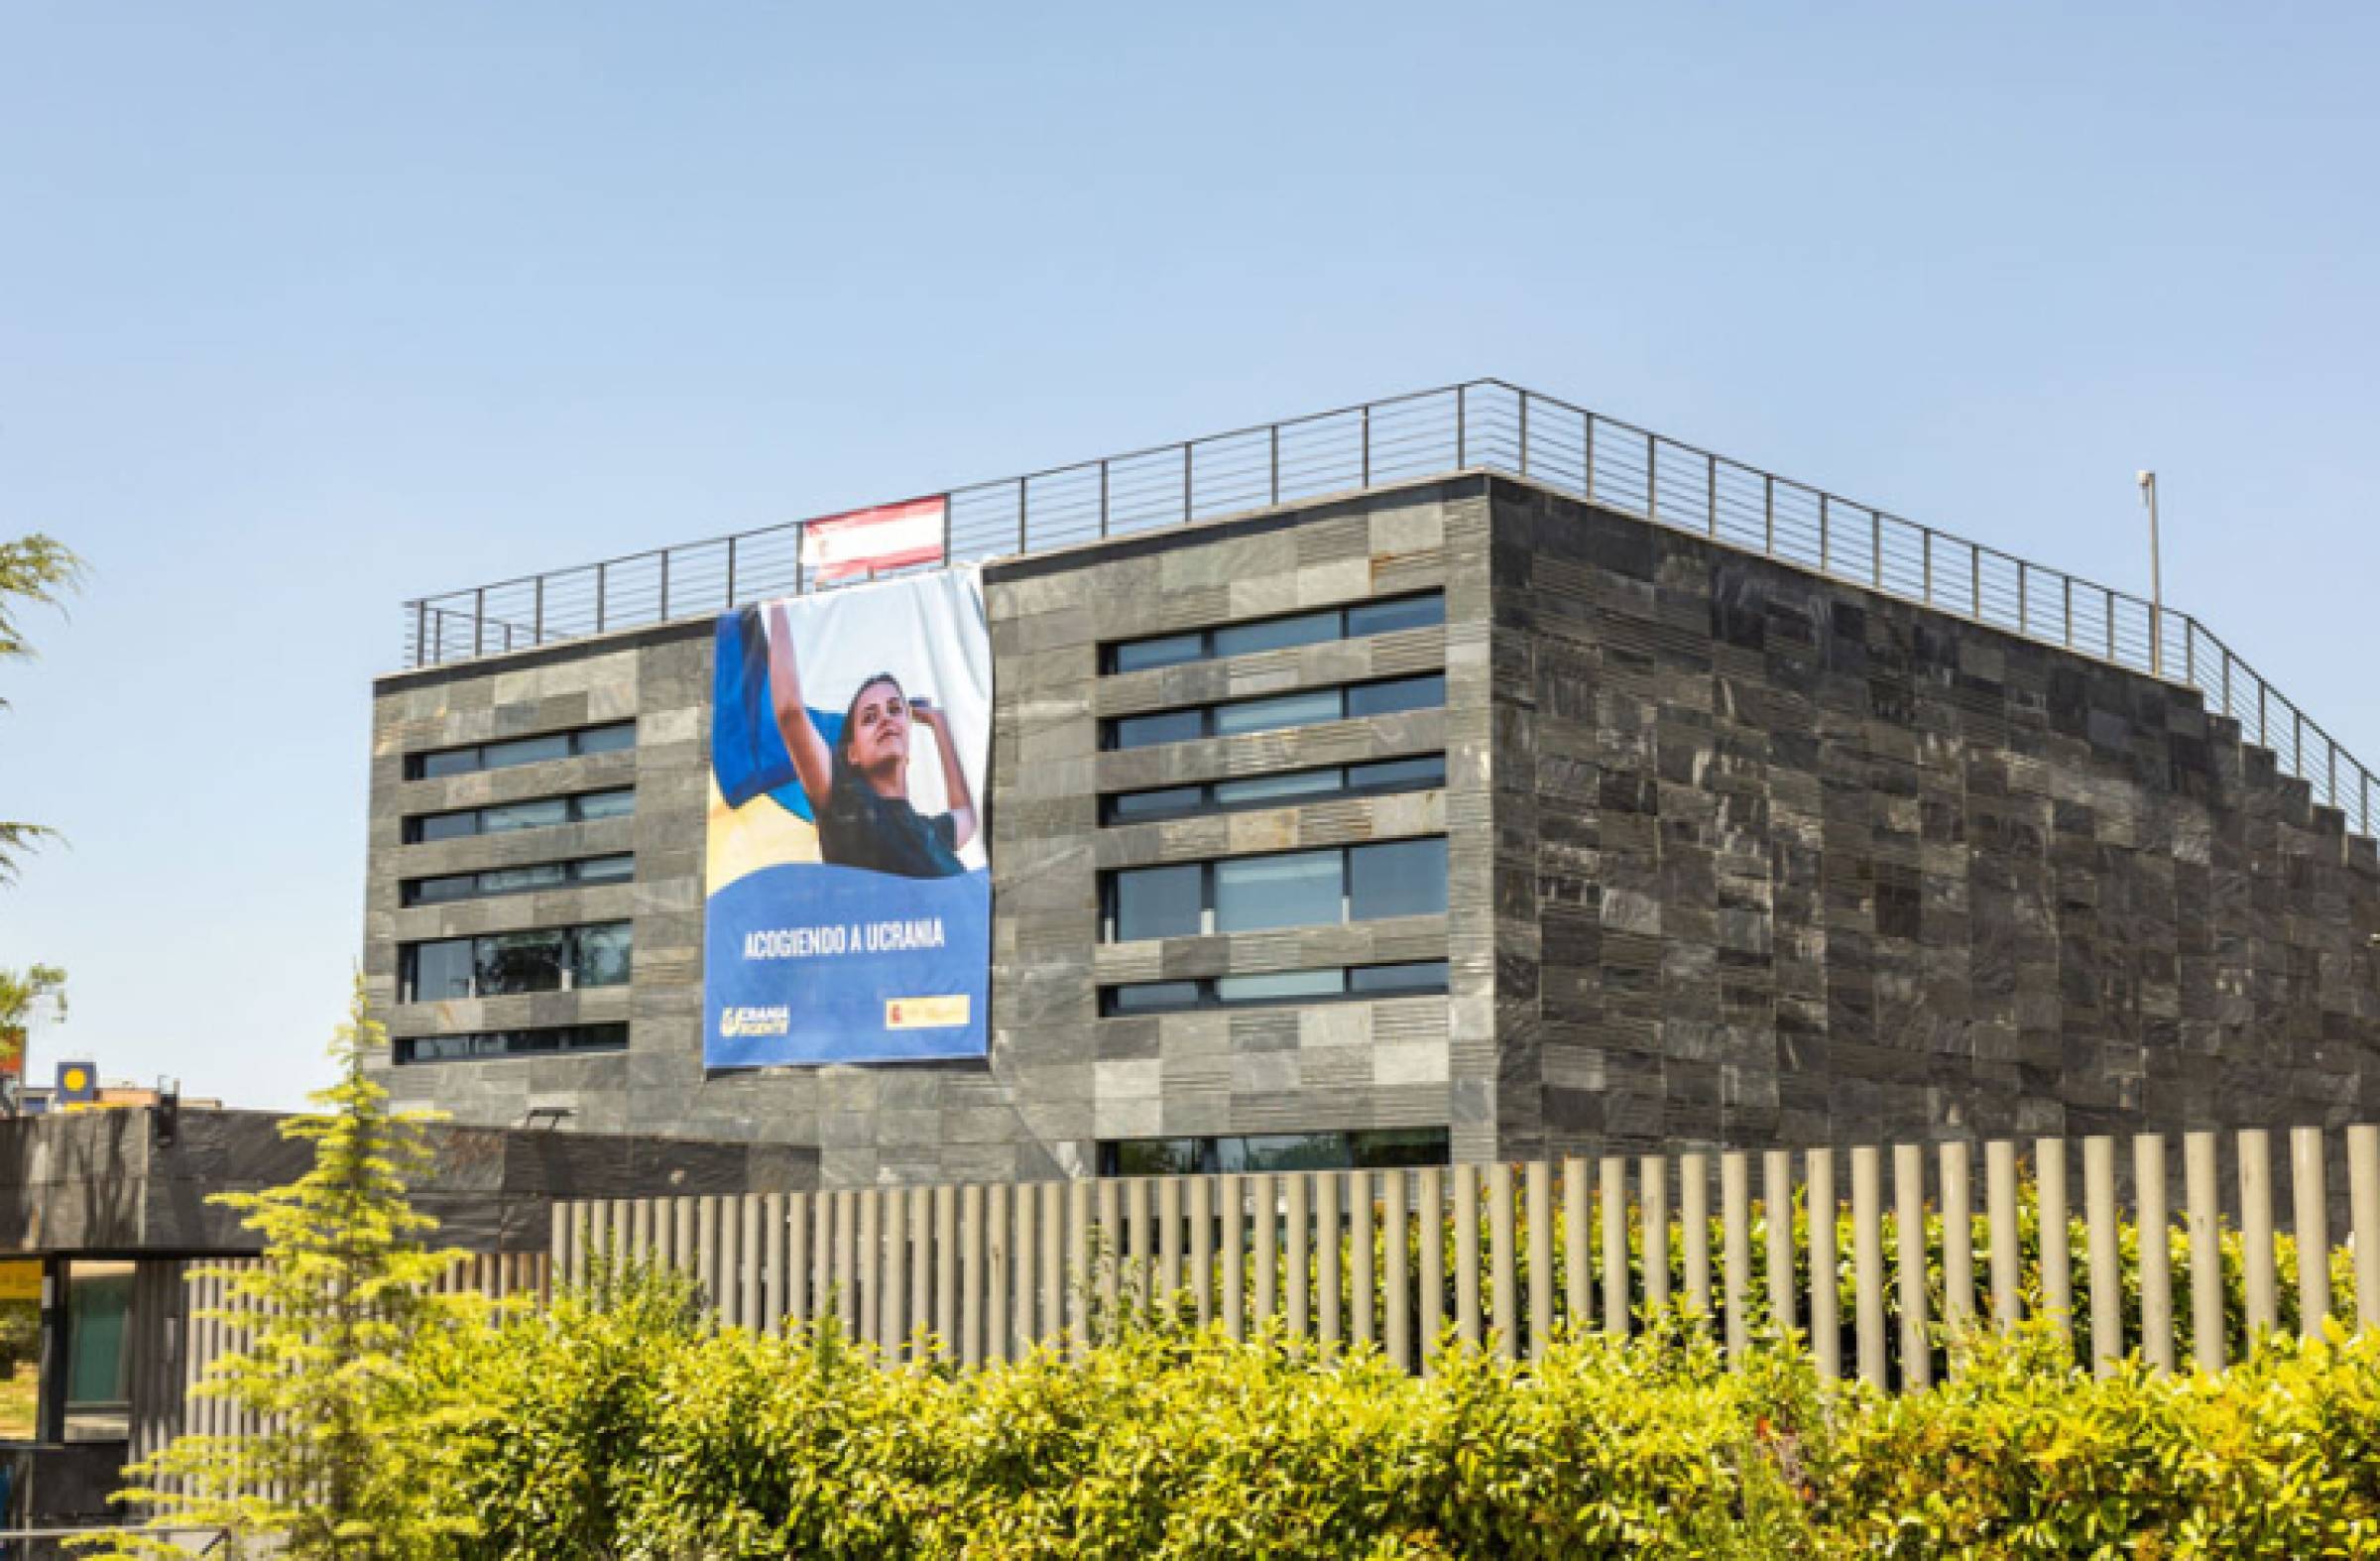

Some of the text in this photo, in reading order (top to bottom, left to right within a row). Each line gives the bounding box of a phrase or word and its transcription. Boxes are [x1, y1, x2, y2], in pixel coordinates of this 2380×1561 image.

[744, 916, 945, 960] ACOGIENDO A UCRANIA
